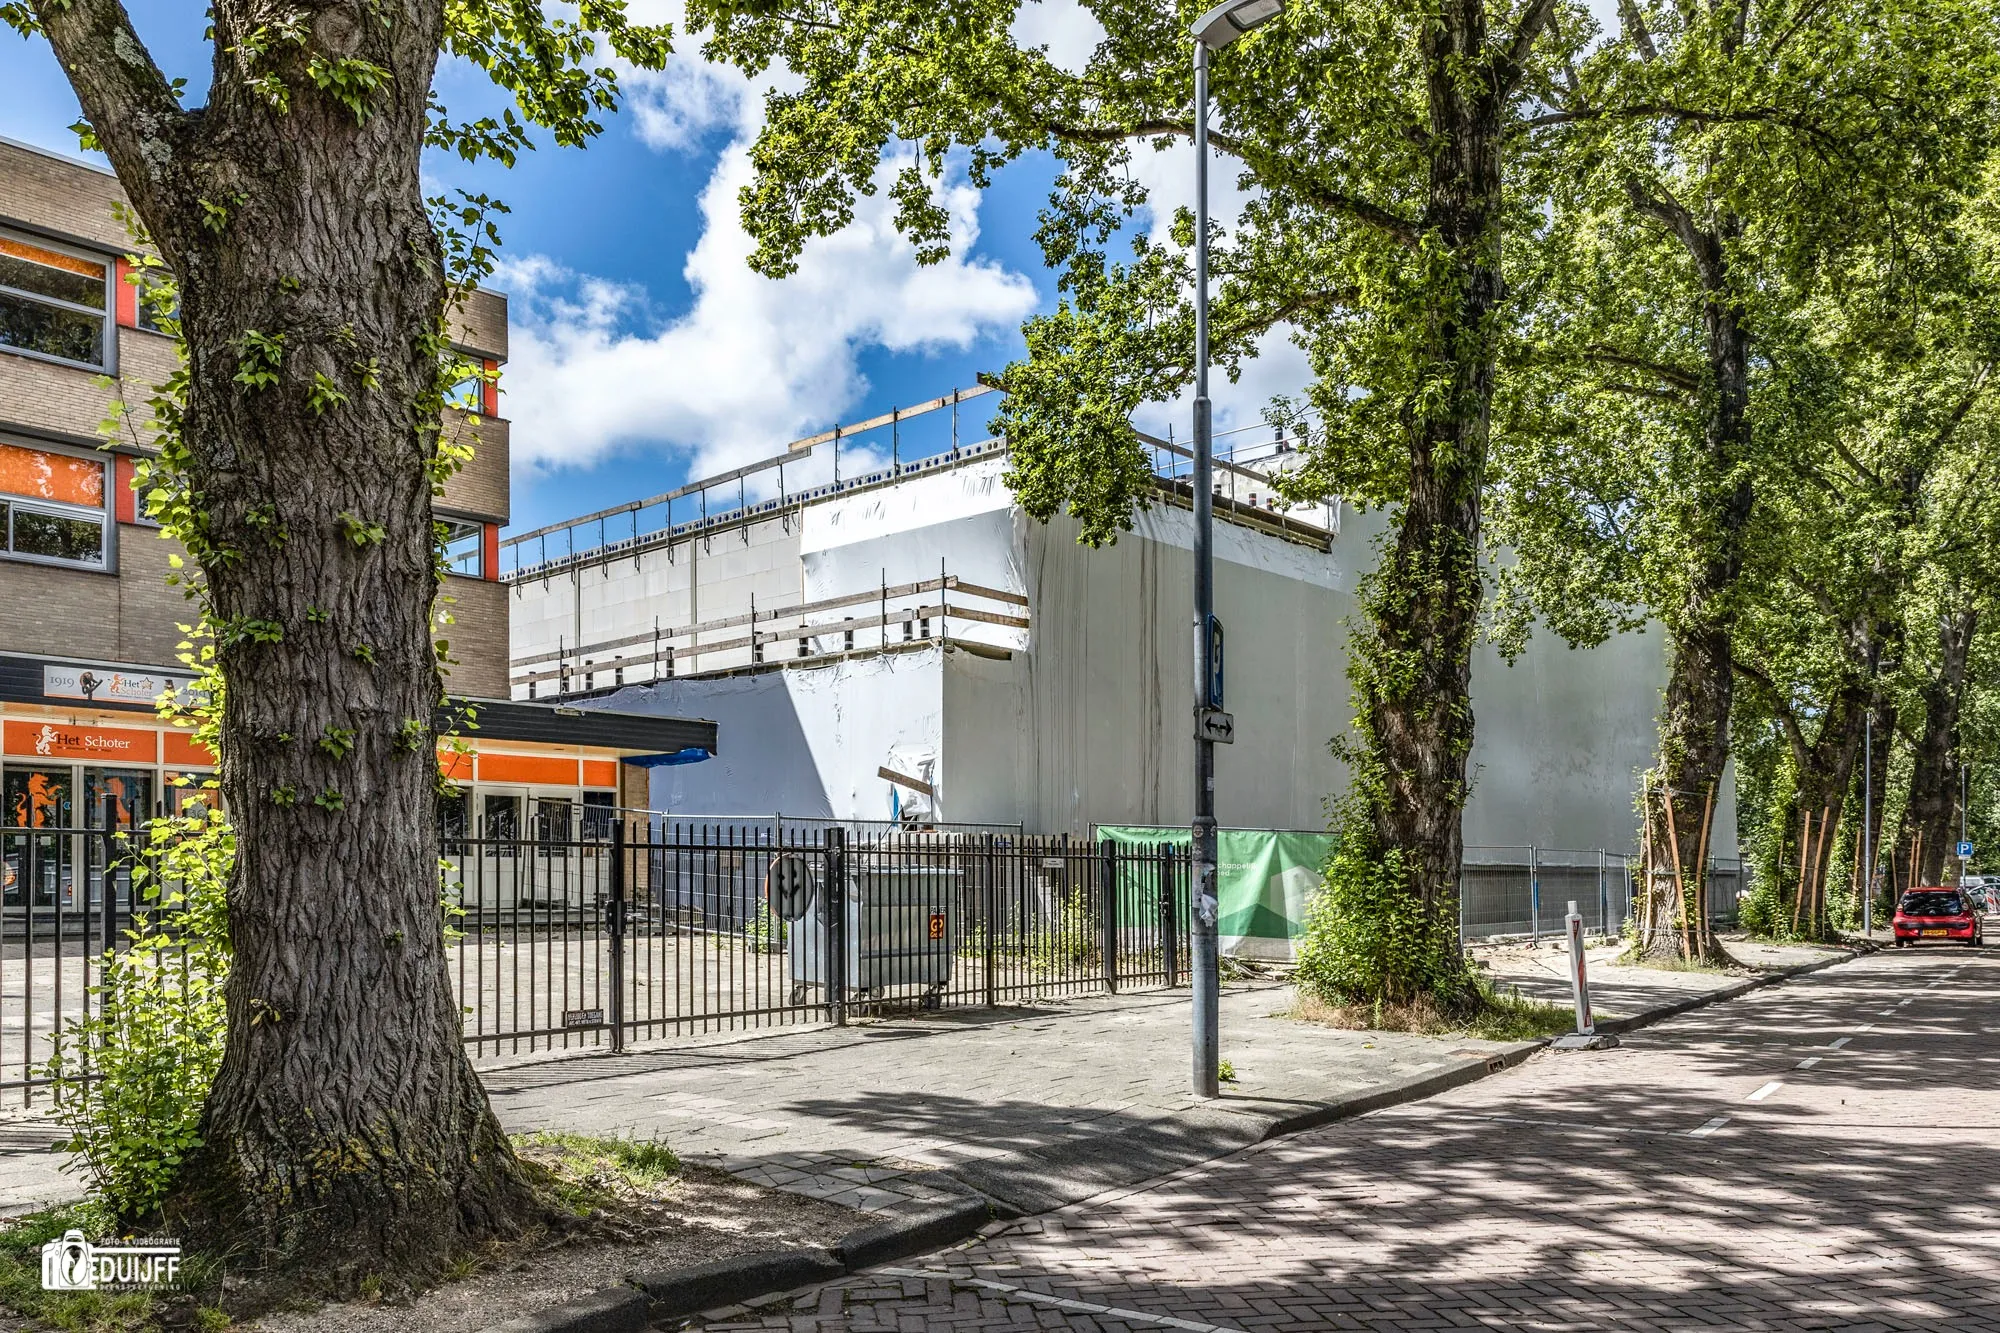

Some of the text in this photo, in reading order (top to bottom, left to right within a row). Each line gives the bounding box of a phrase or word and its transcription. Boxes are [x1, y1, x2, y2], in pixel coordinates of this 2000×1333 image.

[50, 676, 75, 688] 1919
[124, 680, 139, 688] Het
[120, 687, 152, 696] Schoter
[57, 734, 130, 748] Het Schoter
[1960, 844, 1970, 854] P
